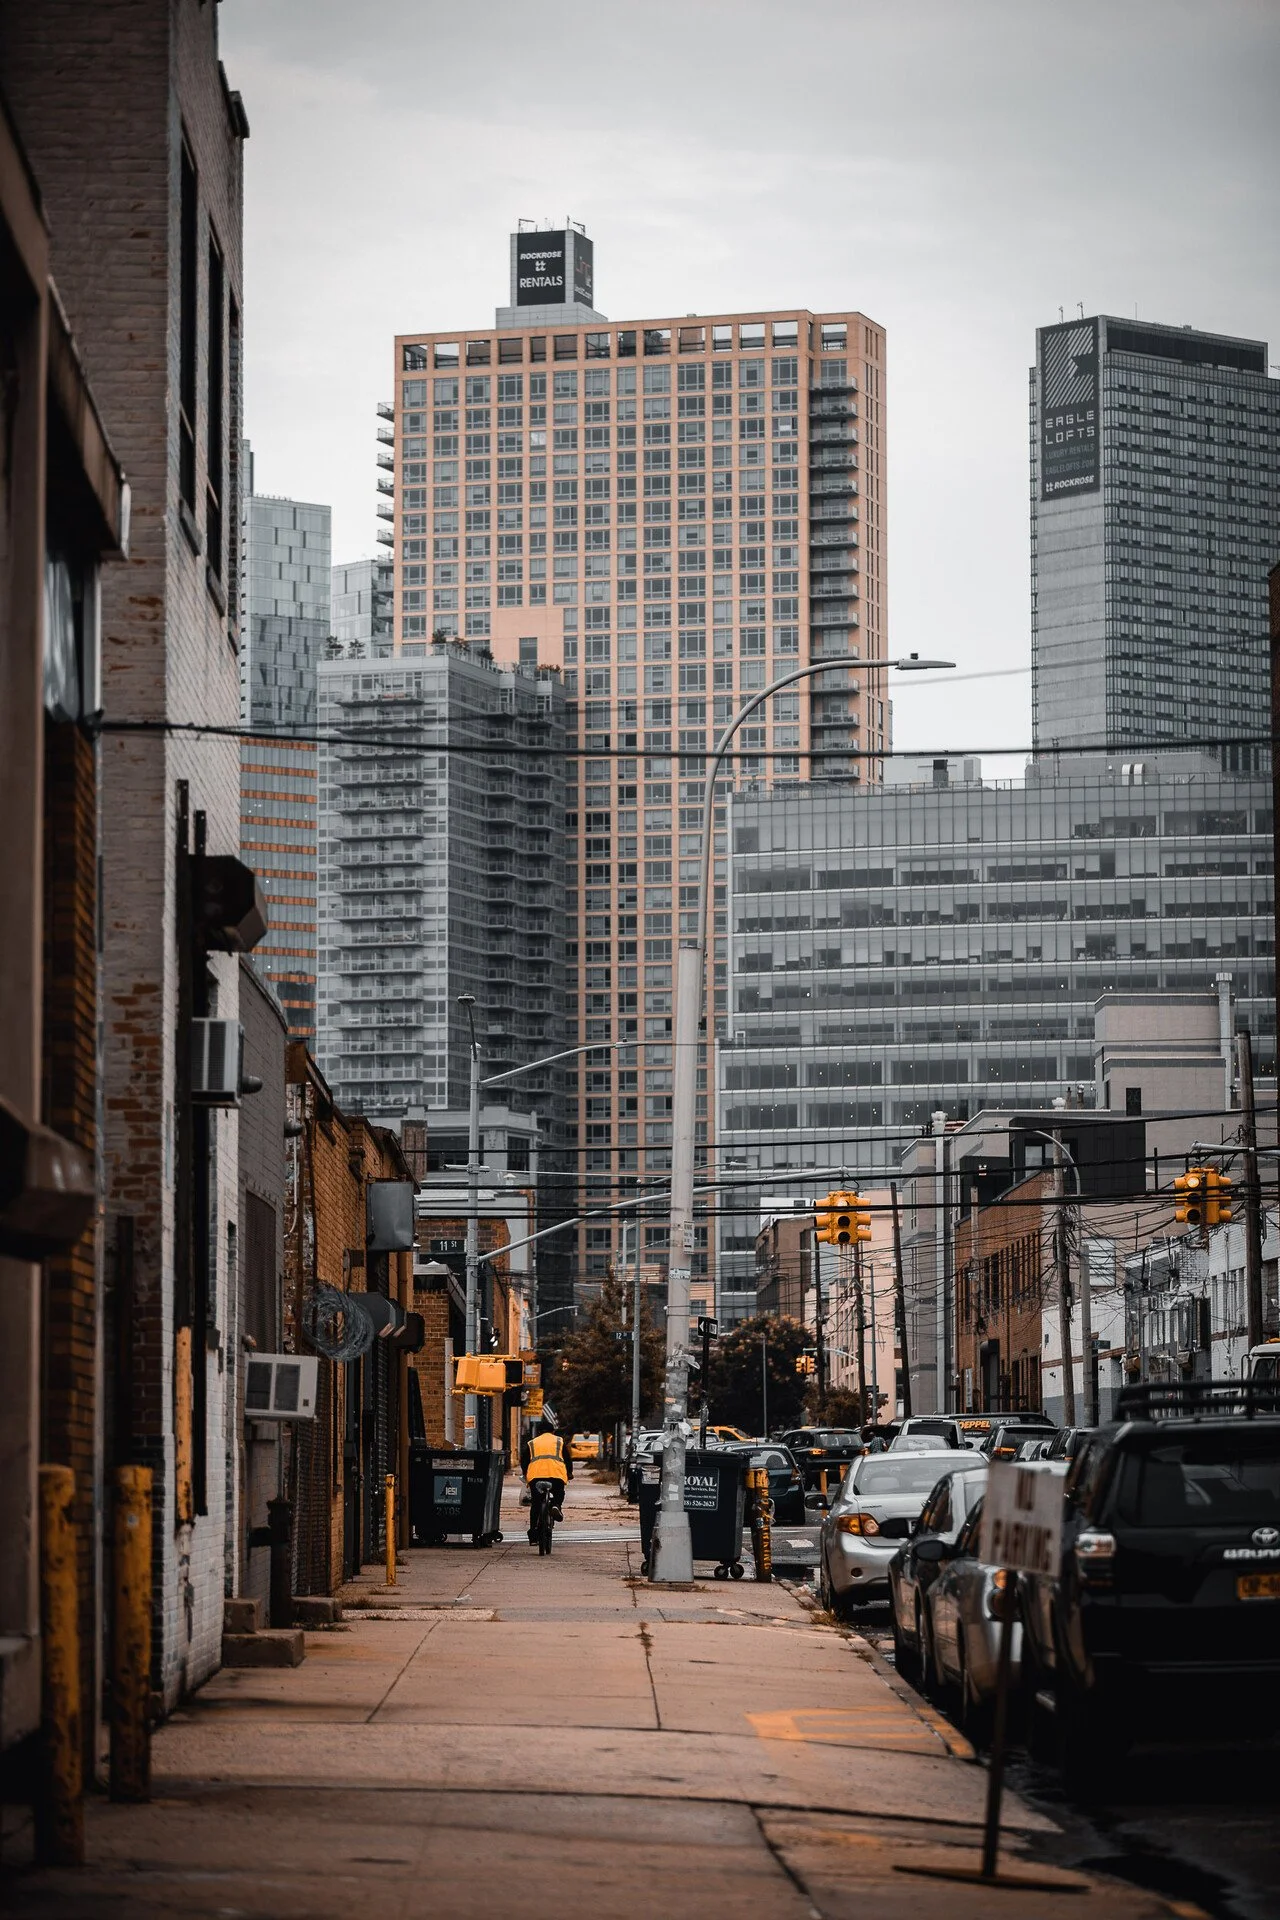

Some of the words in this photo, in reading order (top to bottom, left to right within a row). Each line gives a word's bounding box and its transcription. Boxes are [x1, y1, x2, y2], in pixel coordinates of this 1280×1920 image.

[520, 250, 562, 260] ROCKROSE
[520, 276, 563, 288] RENTALS
[1045, 410, 1095, 429] EAGLE
[1045, 426, 1095, 445] LOFTS
[1069, 443, 1095, 455] RENTALS
[1054, 475, 1095, 490] ROCKROSE
[440, 1241, 448, 1251] 11
[616, 1332, 622, 1340] 12
[958, 1419, 991, 1430] OEPPEL
